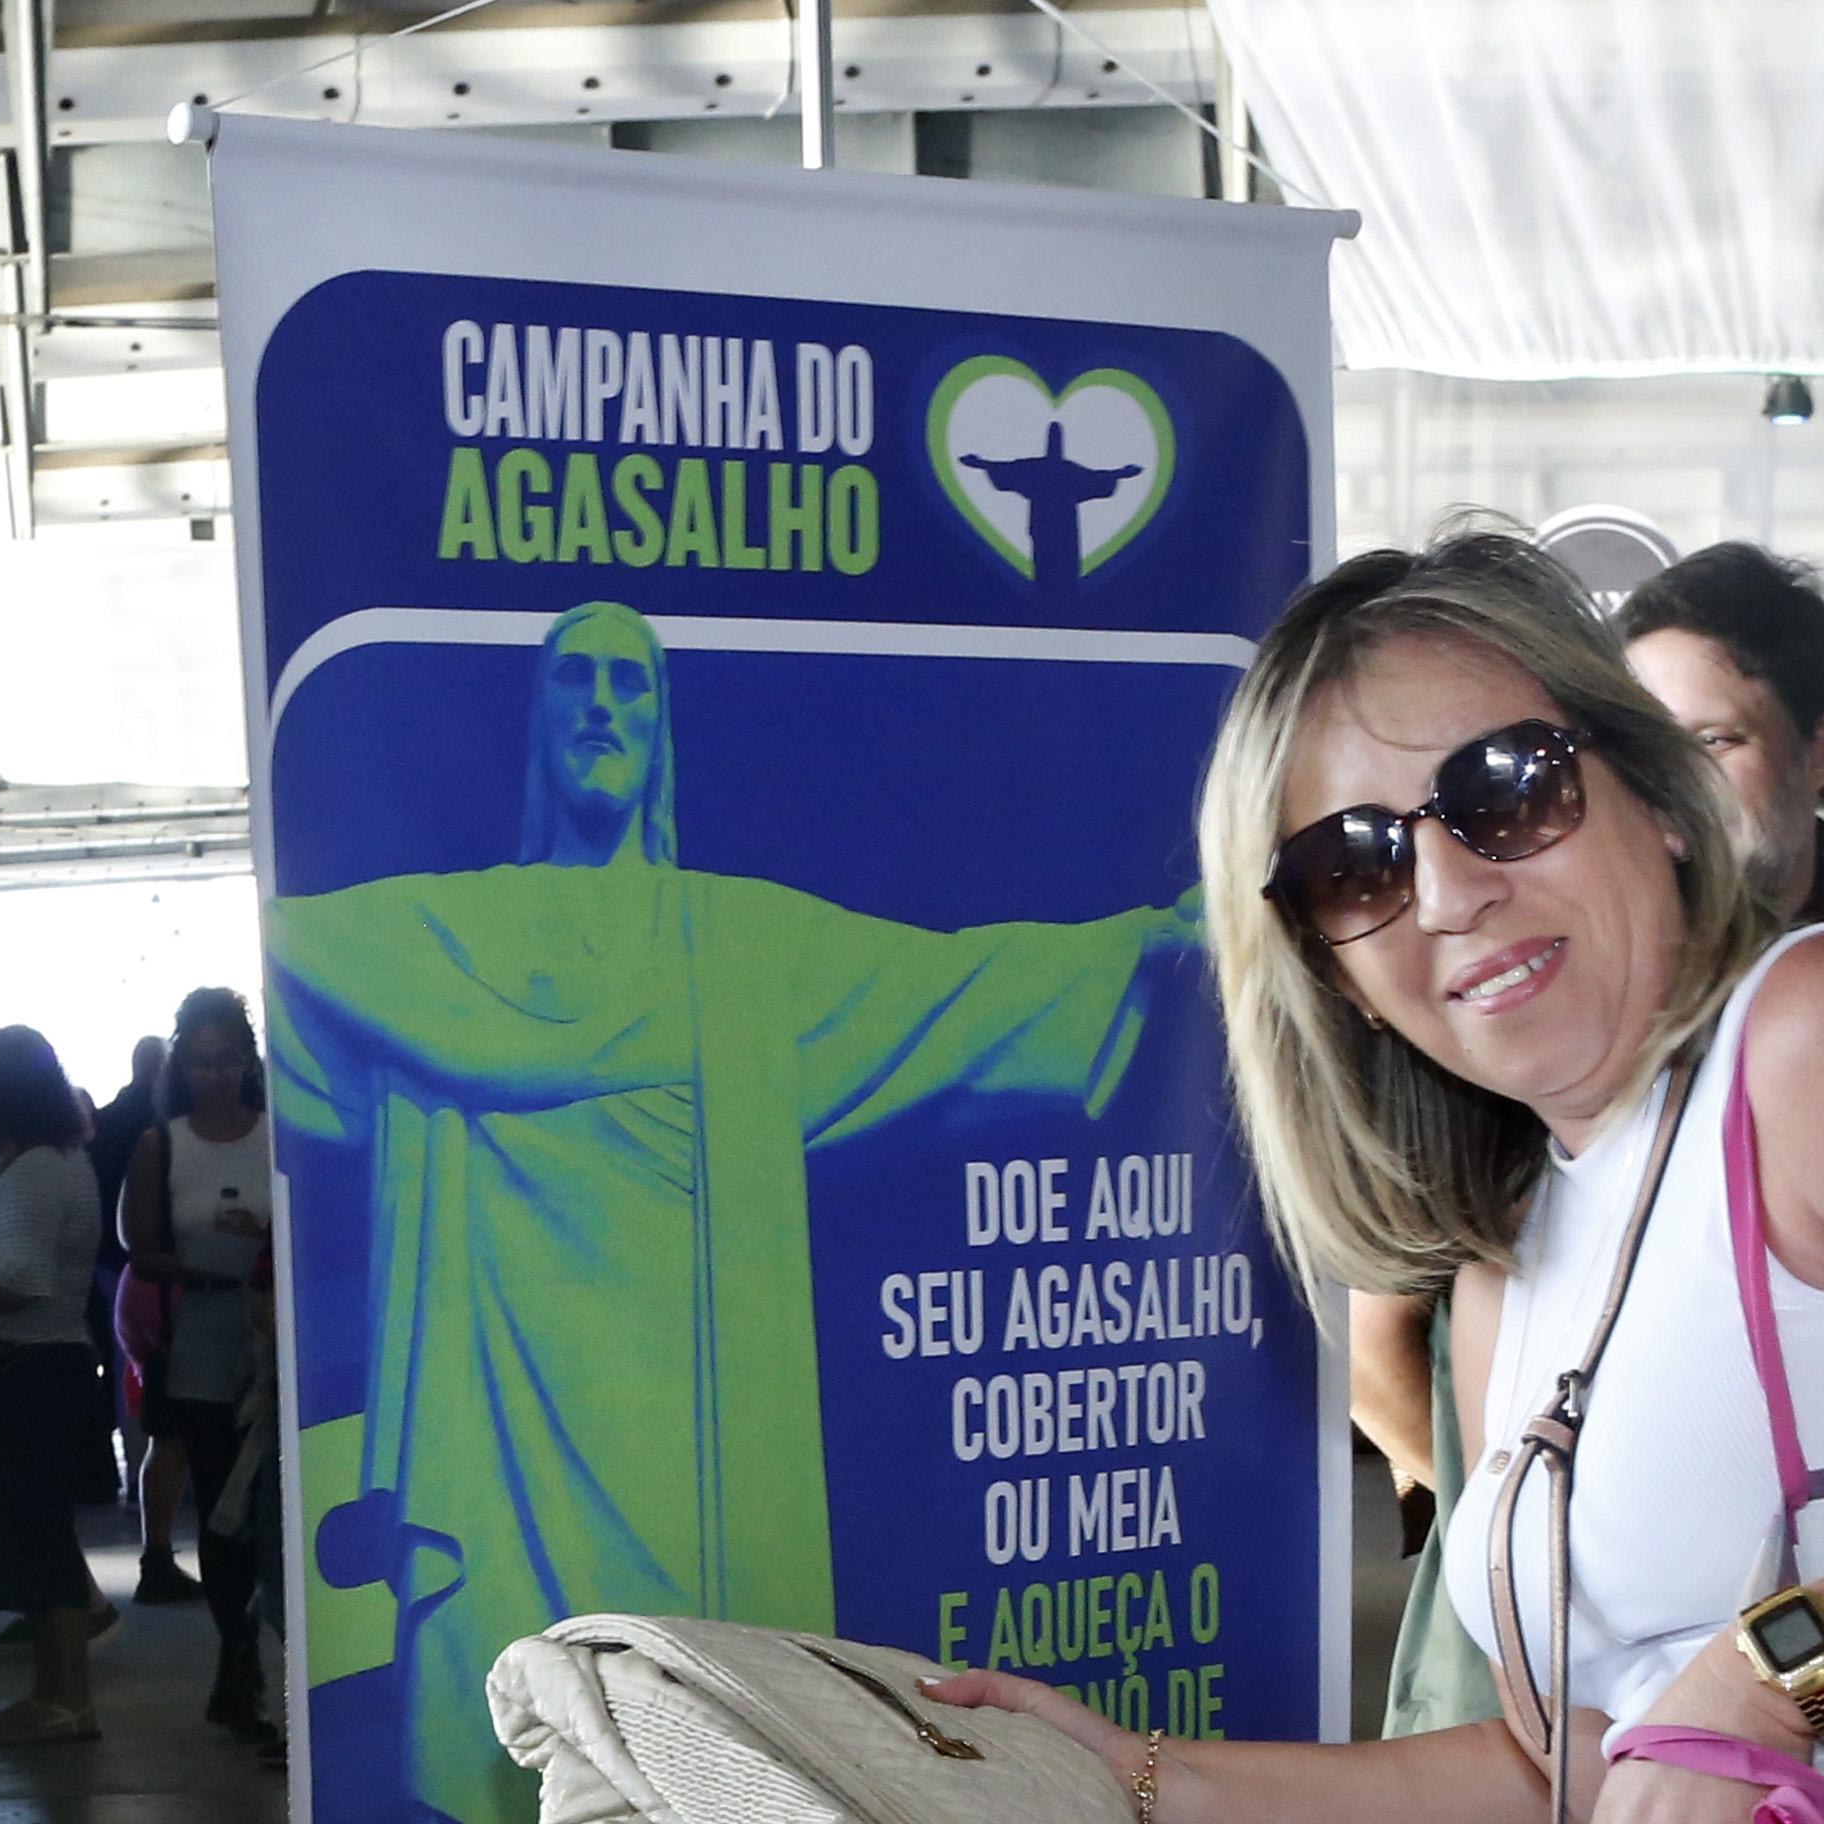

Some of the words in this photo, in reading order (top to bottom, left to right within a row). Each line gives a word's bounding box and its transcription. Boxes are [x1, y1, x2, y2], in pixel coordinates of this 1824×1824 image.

[442, 319, 784, 451] CAMPANHA
[796, 341, 874, 456] DO
[437, 447, 880, 576] AGASALHO
[965, 1158, 1070, 1246] DOE
[1085, 1153, 1193, 1241] AQUI
[880, 1269, 984, 1360] SEU
[1003, 1252, 1264, 1351] AGASALHO,
[952, 1360, 1207, 1462] COBERTOR
[984, 1478, 1050, 1566] OU
[1068, 1465, 1182, 1557] MEIA
[939, 1592, 968, 1673] E
[988, 1569, 1174, 1677] AQUEÇA
[1190, 1563, 1221, 1645] O
[1168, 1664, 1225, 1740] DE
